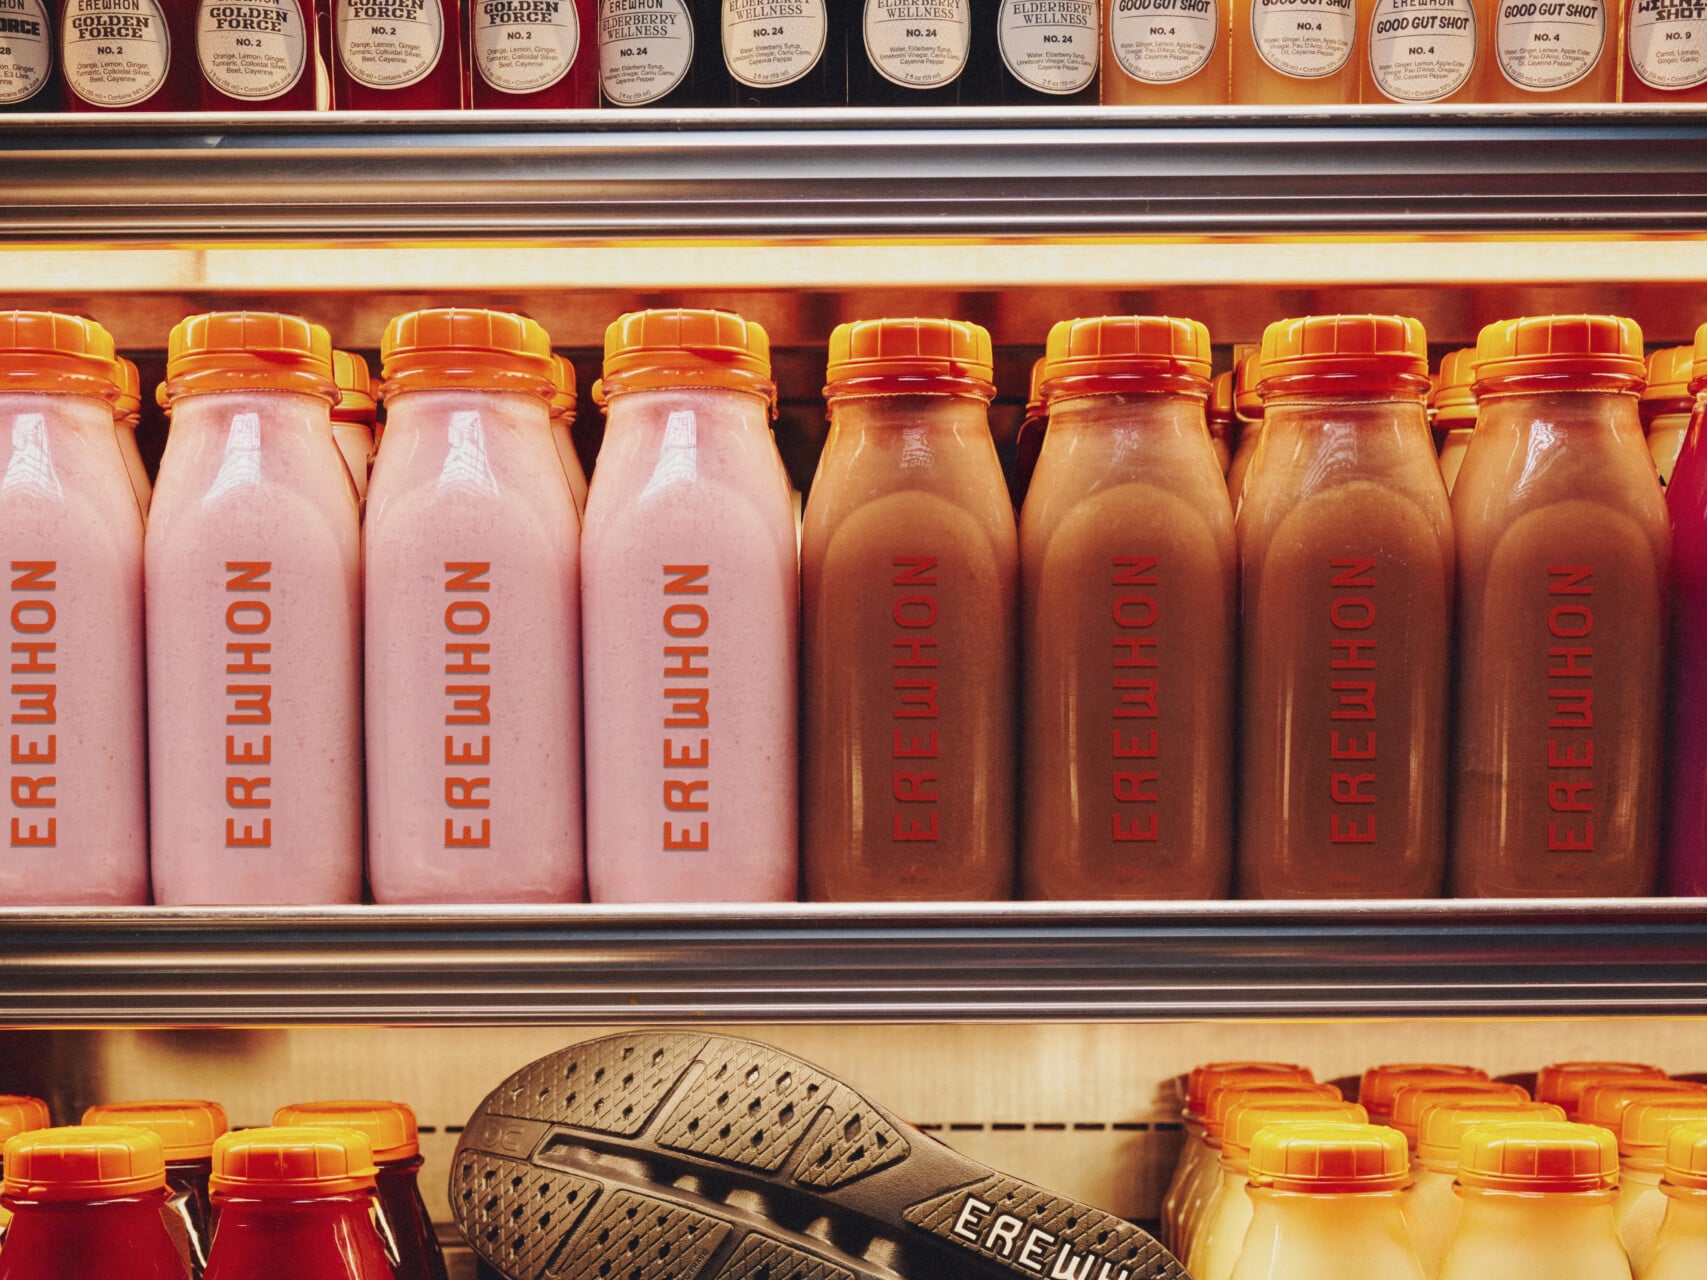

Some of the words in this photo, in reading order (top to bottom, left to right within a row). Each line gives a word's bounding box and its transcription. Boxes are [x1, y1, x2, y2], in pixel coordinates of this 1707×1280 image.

[78, 0, 139, 11] EREWHON
[348, 0, 425, 10] GOLDEN
[484, 1, 559, 14] GOLDEN
[609, 0, 663, 13] EREWHON
[1013, 2, 1093, 15] ELDERBERRY
[1119, 0, 1152, 12] GOOD
[1153, 0, 1179, 10] GUT
[1180, 0, 1211, 13] SHOT
[1504, 3, 1537, 18] GOOD
[1538, 3, 1565, 16] GUT
[1565, 4, 1598, 19] SHOT
[1639, 0, 1707, 13] WELLNE
[210, 7, 288, 22] GOLDEN
[353, 7, 417, 20] FORCE
[489, 12, 553, 25] FORCE
[736, 5, 803, 20] WELLNESS
[886, 7, 955, 19] WELLNESS
[1656, 8, 1706, 21] SHOT
[72, 15, 150, 28] GOLDEN
[216, 19, 282, 32] FORCE
[602, 14, 678, 31] ELDERBERRY
[1022, 13, 1088, 26] WELLNESS
[1377, 17, 1410, 34] GOOD
[1411, 16, 1438, 29] GUT
[1438, 16, 1470, 31] SHOT
[78, 26, 143, 39] FORCE
[371, 27, 388, 35] NO.
[607, 25, 668, 39] WELLNESS
[753, 28, 770, 37] NO.
[771, 26, 784, 36] 24
[906, 29, 924, 37] NO.
[925, 29, 937, 37] 24
[1149, 27, 1167, 35] NO.
[1168, 27, 1176, 35] 4
[1296, 22, 1314, 31] NO.
[1315, 23, 1322, 31] 4
[507, 31, 524, 40] NO.
[525, 31, 532, 39] 2
[1043, 35, 1061, 43] NO.
[1534, 33, 1551, 41] NO.
[1665, 32, 1683, 41] NO.
[1685, 31, 1692, 40] 9
[97, 46, 115, 54] NO.
[116, 46, 123, 54] 2
[236, 39, 254, 47] NO.
[255, 40, 262, 48] 2
[620, 48, 635, 57] NO.
[636, 47, 648, 56] 24
[1408, 46, 1426, 55] NO.
[1427, 46, 1435, 54] 4
[11, 561, 57, 847] EREWHON
[226, 561, 272, 848] EREWHON
[445, 562, 491, 848] EREWHON
[893, 556, 938, 842] EREWHON
[1112, 556, 1158, 842] EREWHON
[1330, 557, 1376, 843] EREWHON
[663, 565, 709, 851] EREWHON
[1548, 565, 1594, 851] EREWHON
